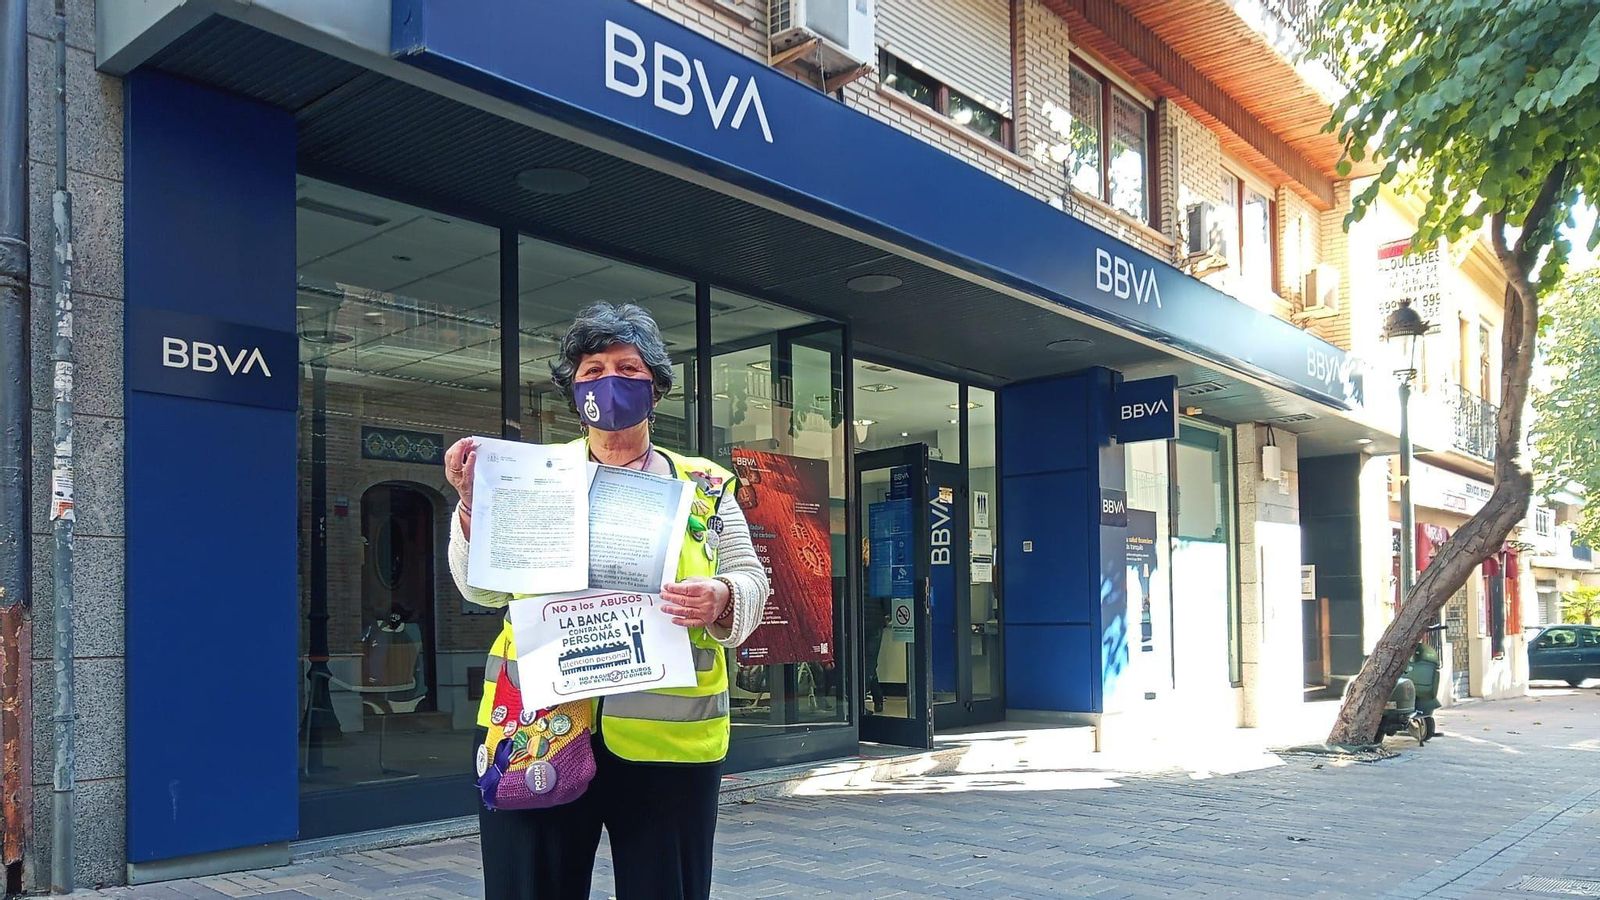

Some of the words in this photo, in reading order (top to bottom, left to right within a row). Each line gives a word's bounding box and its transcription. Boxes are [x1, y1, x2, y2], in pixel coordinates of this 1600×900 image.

[605, 19, 773, 143] BBVA
[1379, 250, 1440, 271] QUILERES
[1096, 247, 1162, 309] BBVA
[162, 336, 272, 378] BBVA
[1121, 399, 1169, 419] BBVA
[736, 456, 757, 466] BBVA
[1102, 498, 1125, 514] BBVA
[929, 495, 951, 565] BBVA
[552, 605, 568, 614] NO
[580, 602, 594, 610] los
[600, 595, 642, 608] ABUSOS
[559, 617, 575, 629] LA
[577, 611, 618, 627] BANCA
[569, 626, 598, 636] CONTRA
[600, 623, 613, 631] LAS
[562, 629, 622, 647] PERSONAS
[596, 651, 628, 663] personal
